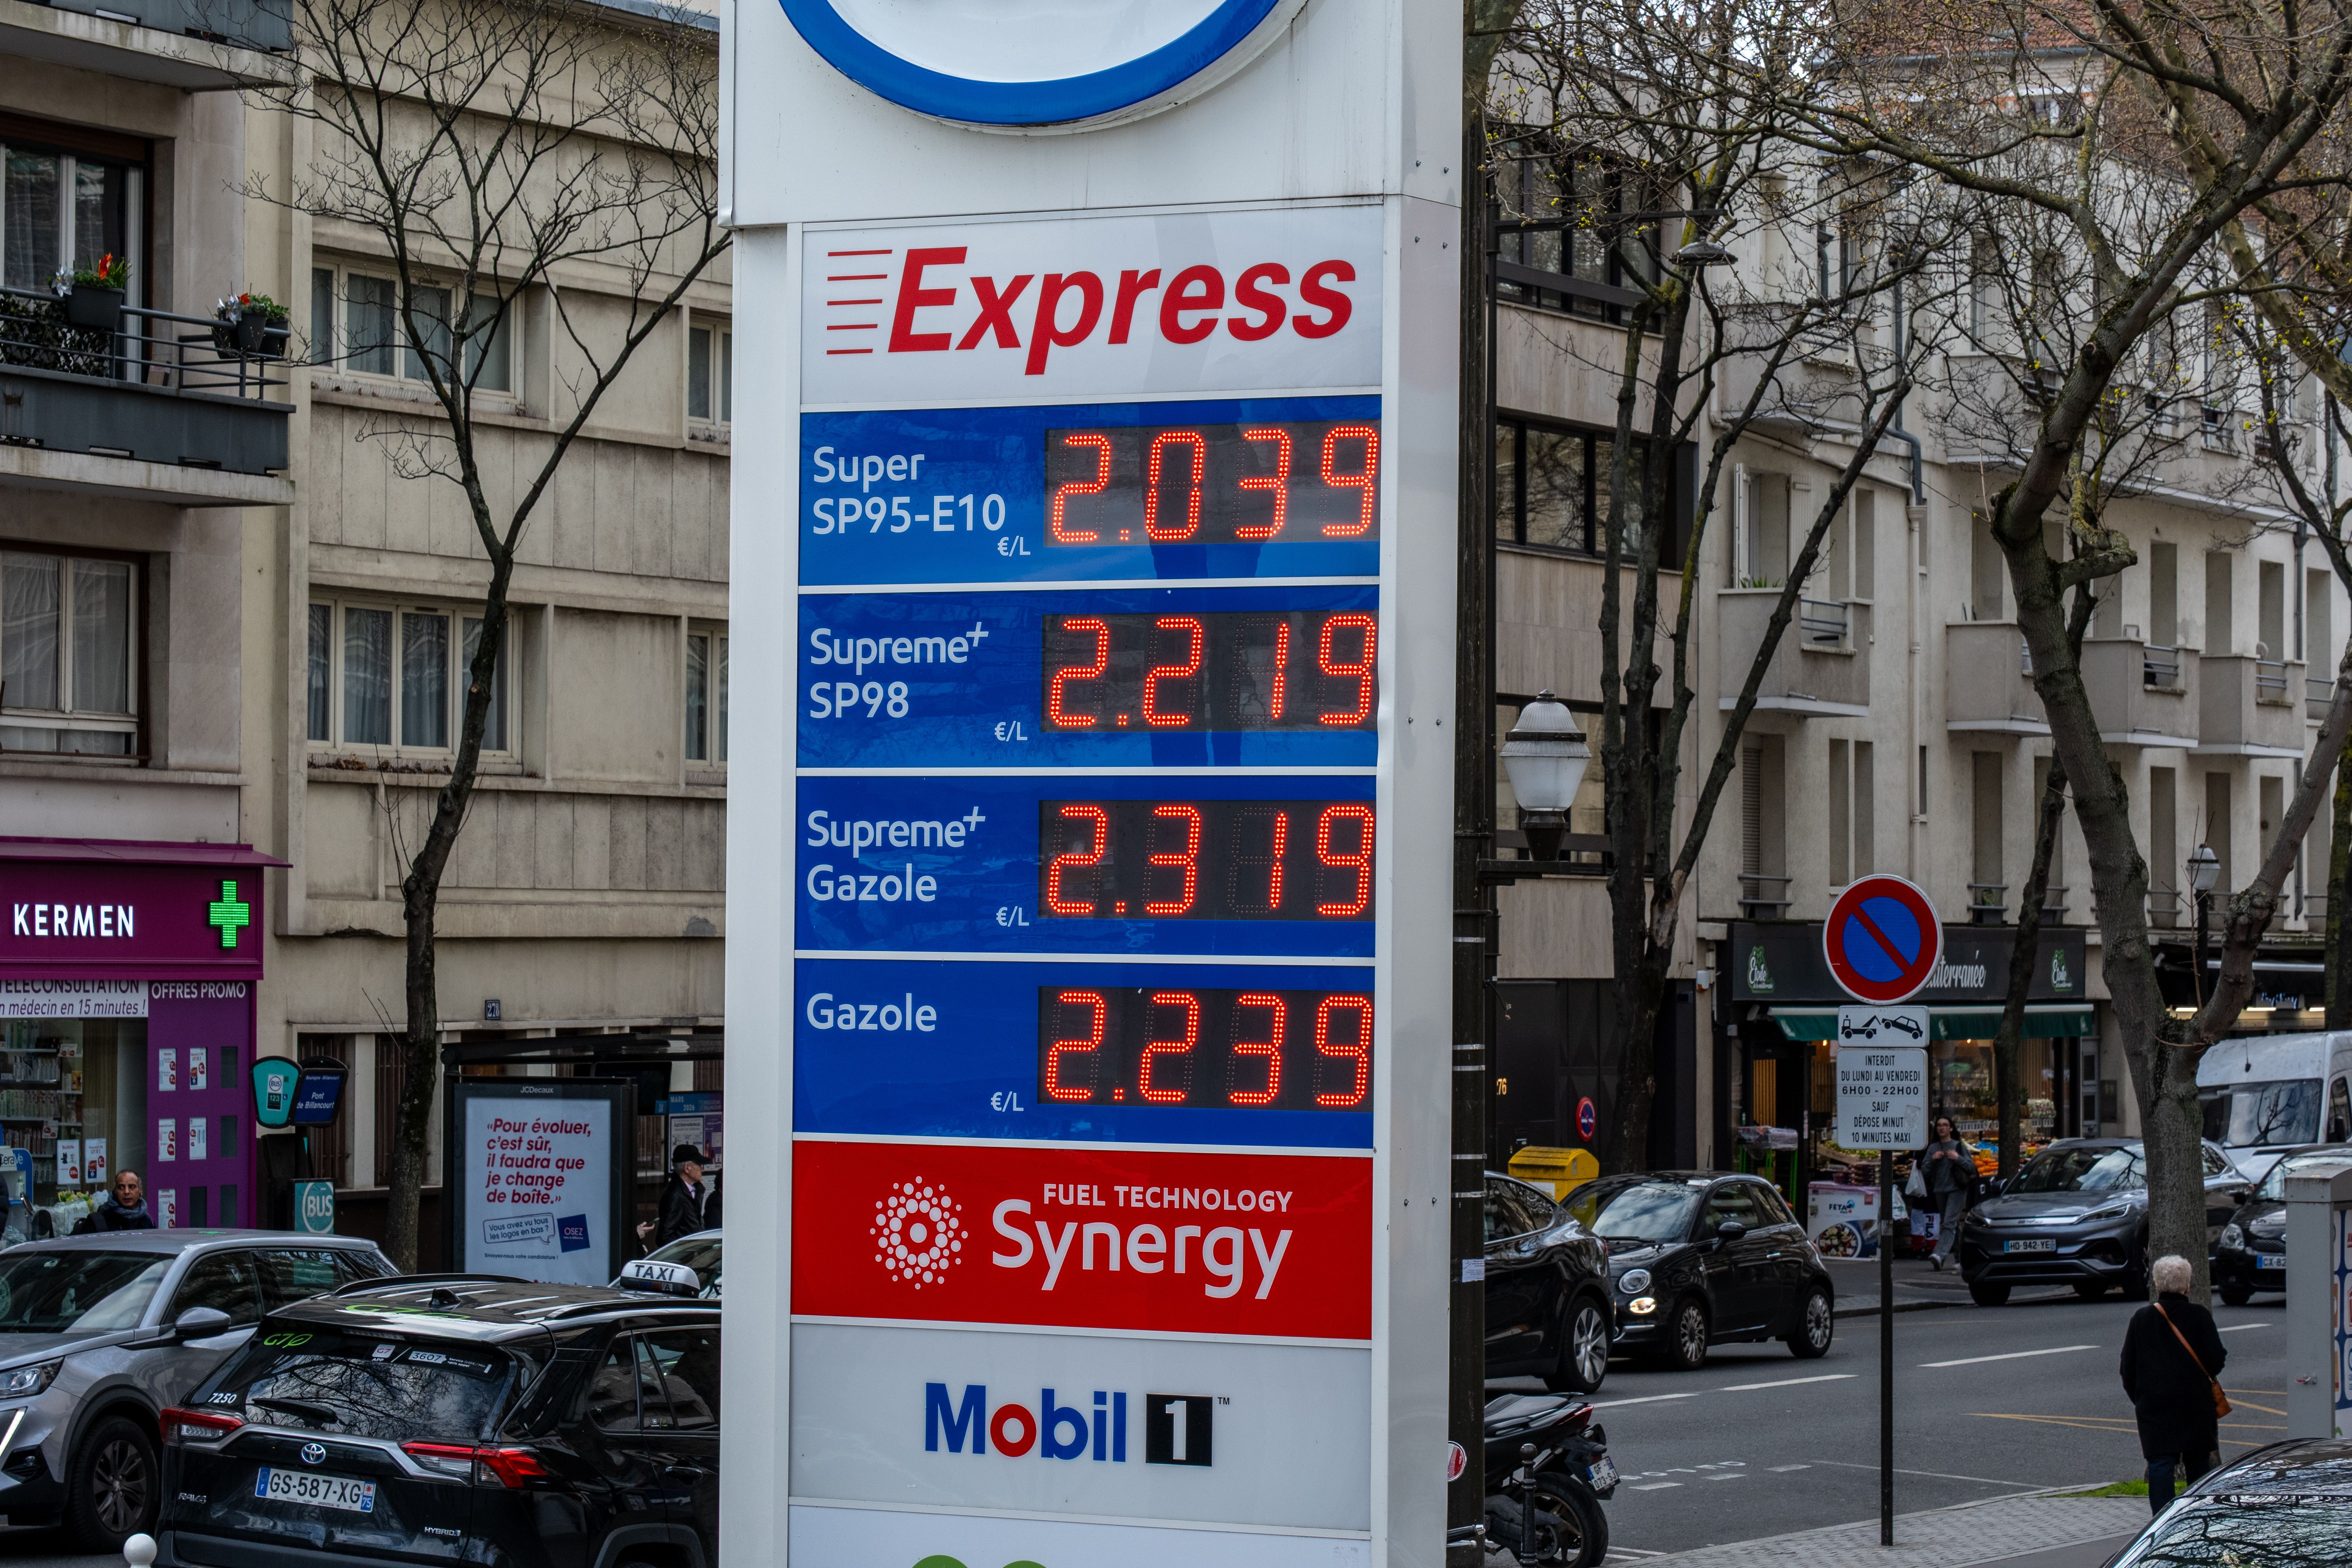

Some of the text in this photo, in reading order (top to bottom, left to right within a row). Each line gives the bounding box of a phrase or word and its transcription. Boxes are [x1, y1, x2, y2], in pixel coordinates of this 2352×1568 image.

[888, 246, 1356, 375] Express
[813, 446, 925, 493] Super
[1052, 426, 1379, 542] 2.039
[813, 493, 1005, 535] SP95-E10
[997, 536, 1032, 556] €/L
[1050, 615, 1375, 726] 2.219
[809, 681, 910, 719] SP98
[994, 721, 1028, 742] €/L
[1047, 806, 1374, 916] 2.319
[807, 863, 938, 902] Gazole
[14, 904, 134, 937] KERMEN
[996, 907, 1029, 927] €/L
[152, 982, 246, 999] OFFRES PROMO
[9, 998, 57, 1015] médecin
[61, 1003, 74, 1015] en
[79, 999, 91, 1015] 15
[94, 999, 138, 1015] minutes
[142, 999, 146, 1015] !
[487, 1002, 499, 1017] 278
[806, 992, 937, 1032] Gazole
[1046, 992, 1372, 1105] 2.239
[1865, 1055, 1895, 1066] INTERDIT
[1841, 1071, 1920, 1082] DU LUNDI AU VENDREDI
[1496, 1078, 1507, 1095] 76
[1842, 1086, 1871, 1095] 6H00
[1883, 1086, 1919, 1095] 22H00
[305, 1101, 334, 1109] Billancourt
[990, 1092, 1024, 1112] €/L
[1872, 1102, 1889, 1112] SAUF
[531, 1117, 591, 1137] évoluer,
[1854, 1114, 1904, 1128] DÉPOSE MINUT
[526, 1135, 552, 1154] sûr,
[1852, 1132, 1911, 1143] 10 MINUTES MAXI
[486, 1153, 585, 1172] il faudra que
[485, 1171, 565, 1191] je change
[486, 1189, 506, 1203] de
[1043, 1183, 1293, 1213] FUEL TECHNOLOGY
[307, 1195, 333, 1217] BUS
[501, 1229, 519, 1239] logos
[564, 1227, 583, 1236] OSEZ
[1925, 1215, 1935, 1238] FILA
[992, 1199, 1293, 1300] Synergy
[635, 1264, 674, 1281] TAXI
[263, 1333, 295, 1346] G7
[412, 1352, 442, 1362] 3607
[208, 1393, 237, 1404] 7250
[925, 1382, 1127, 1463] Mobil
[270, 1473, 361, 1503] GS-587-XG
[1594, 1471, 1617, 1488] 073-SJ
[178, 1492, 207, 1504] RAV4
[361, 1497, 372, 1508] 75
[424, 1526, 455, 1536] HYBRID
